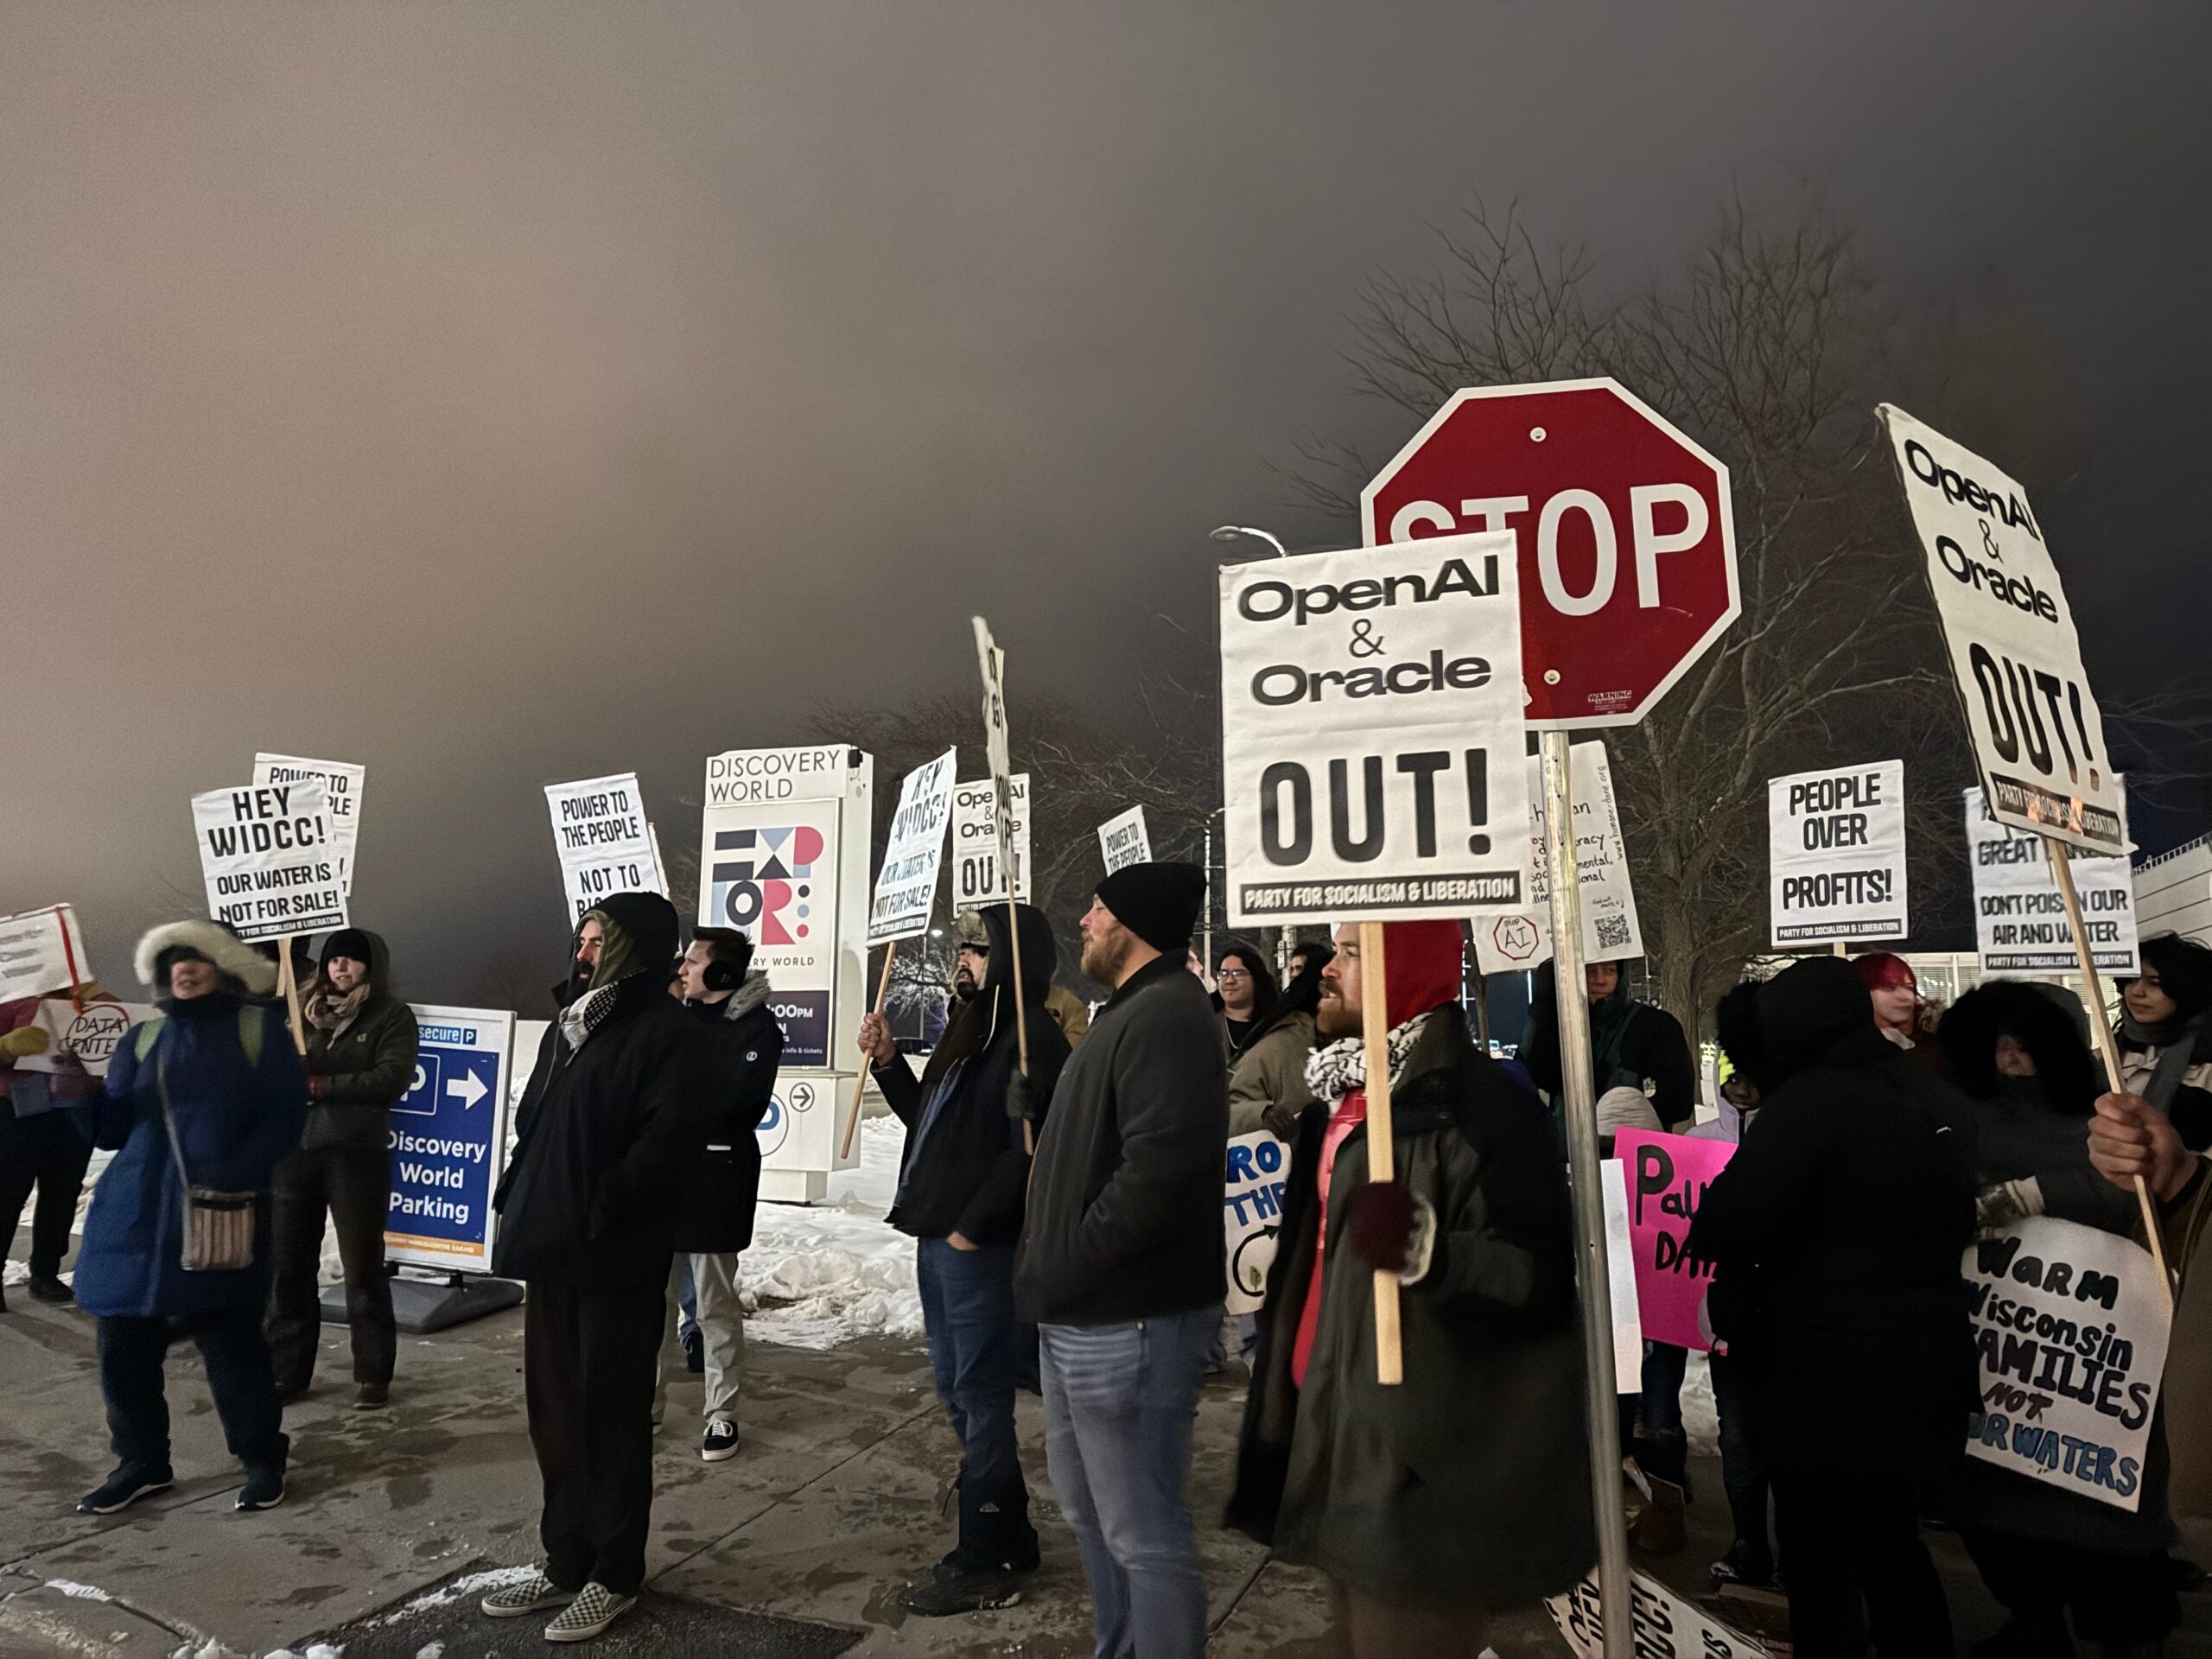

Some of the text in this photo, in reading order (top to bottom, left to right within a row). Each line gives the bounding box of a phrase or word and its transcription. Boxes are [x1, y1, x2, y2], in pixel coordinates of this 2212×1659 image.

[1904, 438, 2041, 541] OpenAI
[1978, 518, 2004, 563] &
[1237, 555, 1499, 626] OpenAI
[1936, 535, 2059, 624] Oracle
[1349, 618, 1387, 658] &
[1251, 649, 1491, 707] Oracle
[1588, 690, 1631, 702] WARNING
[1969, 642, 2101, 792] OUT!
[710, 749, 841, 779] DISCOVERY
[329, 774, 347, 793] TO
[710, 779, 792, 802] WORLD
[957, 783, 1025, 809] OpeAI
[1789, 772, 1881, 816] PEOPLE
[1996, 781, 2024, 807] PARTY
[232, 786, 290, 821] HEY
[561, 791, 628, 822] POWER TO
[1260, 747, 1491, 867] OUT!
[207, 816, 326, 857] WIDCC!
[562, 817, 640, 849] THE PEOPLE
[1106, 827, 1129, 855] POWER
[1803, 813, 1868, 851] OVER
[1978, 837, 2038, 866] GREAT
[217, 874, 253, 895] OUR
[253, 866, 314, 890] WATER
[315, 862, 332, 881] IS
[580, 863, 641, 894] NOT TO
[1243, 878, 1516, 909] PARTY FOR SOCIALISM & LIBERATION
[1783, 868, 1892, 910] PROFITS!
[219, 890, 340, 923] NOT FOR SALE!
[873, 893, 890, 918] NOT
[889, 890, 906, 914] FOR
[904, 884, 931, 909] SALE!
[2025, 890, 2088, 914] POISN
[2090, 889, 2128, 912] OUR
[1505, 926, 1531, 949] AI
[1779, 928, 1801, 938] PARTY
[1801, 927, 1815, 937] FOR
[1815, 925, 1850, 936] SOCIALISM
[1858, 922, 1899, 933] LIBERATION
[1993, 921, 2120, 944] AIR AND WTER
[772, 957, 815, 966] WORLD
[76, 1017, 123, 1033] DATA
[419, 1027, 459, 1042] secure
[58, 1037, 117, 1054] CENTE
[400, 1162, 463, 1189] World
[389, 1192, 468, 1224] Parking
[1962, 1279, 2133, 1371] Wisconsin
[1970, 1324, 2151, 1430] AMILIES
[1983, 1382, 2054, 1424] NOT
[2012, 1423, 2140, 1497] WATERS
